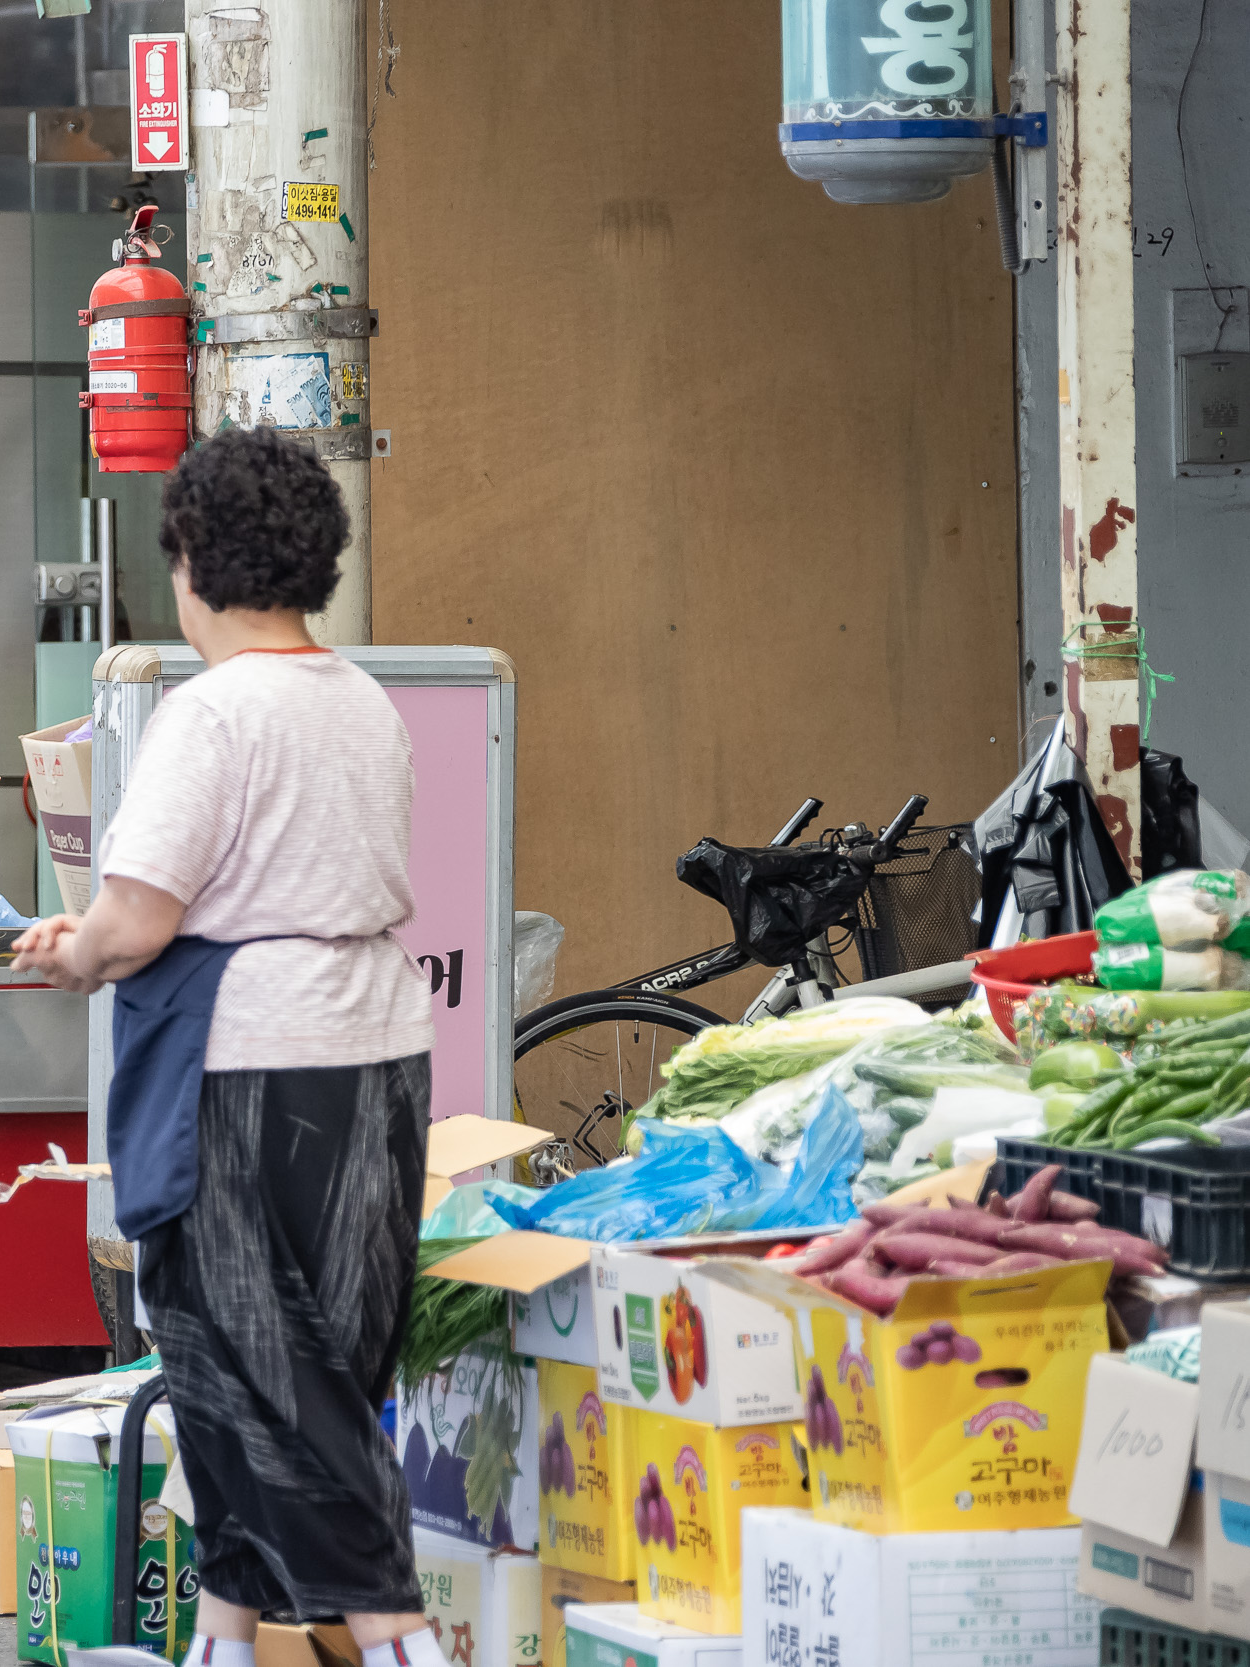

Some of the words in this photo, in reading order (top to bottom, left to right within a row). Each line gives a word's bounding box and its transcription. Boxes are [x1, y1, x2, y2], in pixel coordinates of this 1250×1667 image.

[138, 101, 178, 118] 소화기
[139, 120, 149, 128] FIRE
[149, 119, 178, 128] EXTINGUISHER
[50, 829, 68, 851] Paper
[67, 832, 84, 854] Cup
[1099, 1408, 1164, 1461] 1000
[971, 1457, 1052, 1486] 고구마
